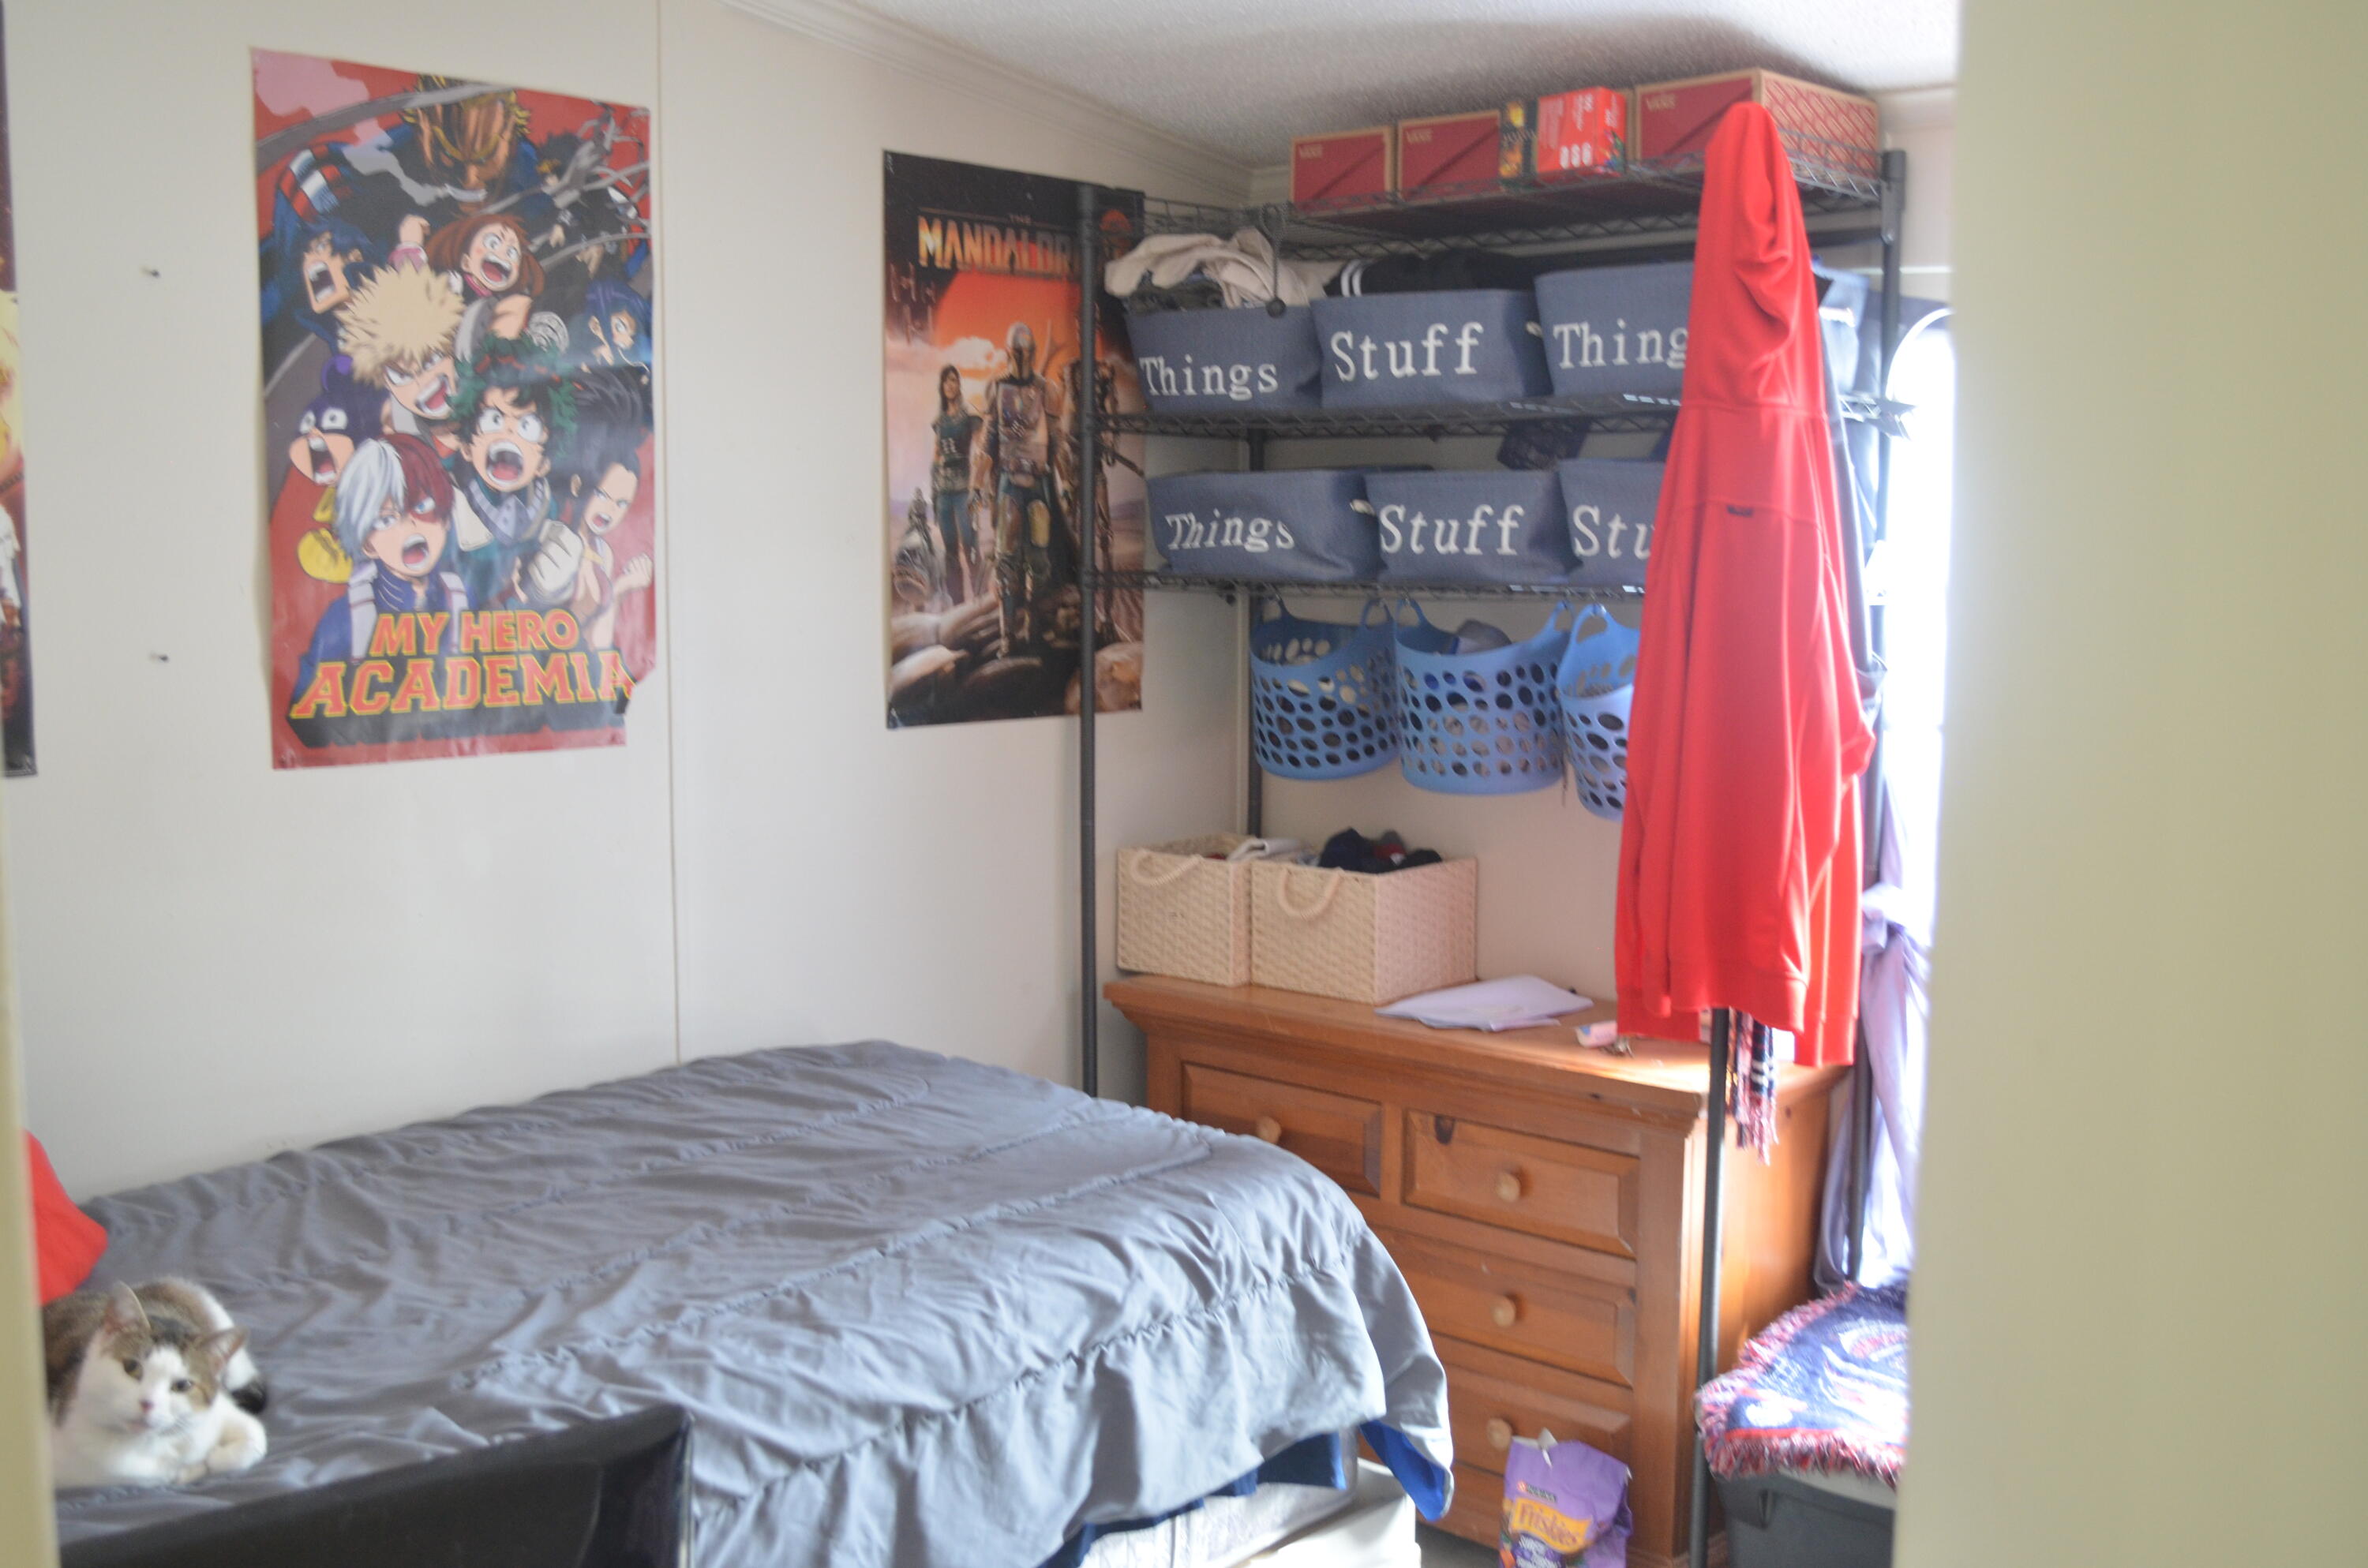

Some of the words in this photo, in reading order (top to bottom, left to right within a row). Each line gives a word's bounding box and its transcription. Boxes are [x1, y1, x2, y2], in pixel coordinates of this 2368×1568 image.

[1330, 322, 1484, 381] Stuff
[1140, 357, 1278, 401] Things
[1166, 509, 1295, 553] Things
[1380, 504, 1524, 554] Stuff
[369, 612, 450, 657] MY
[459, 608, 580, 653] HERO
[290, 652, 637, 719] ACADEMIA
